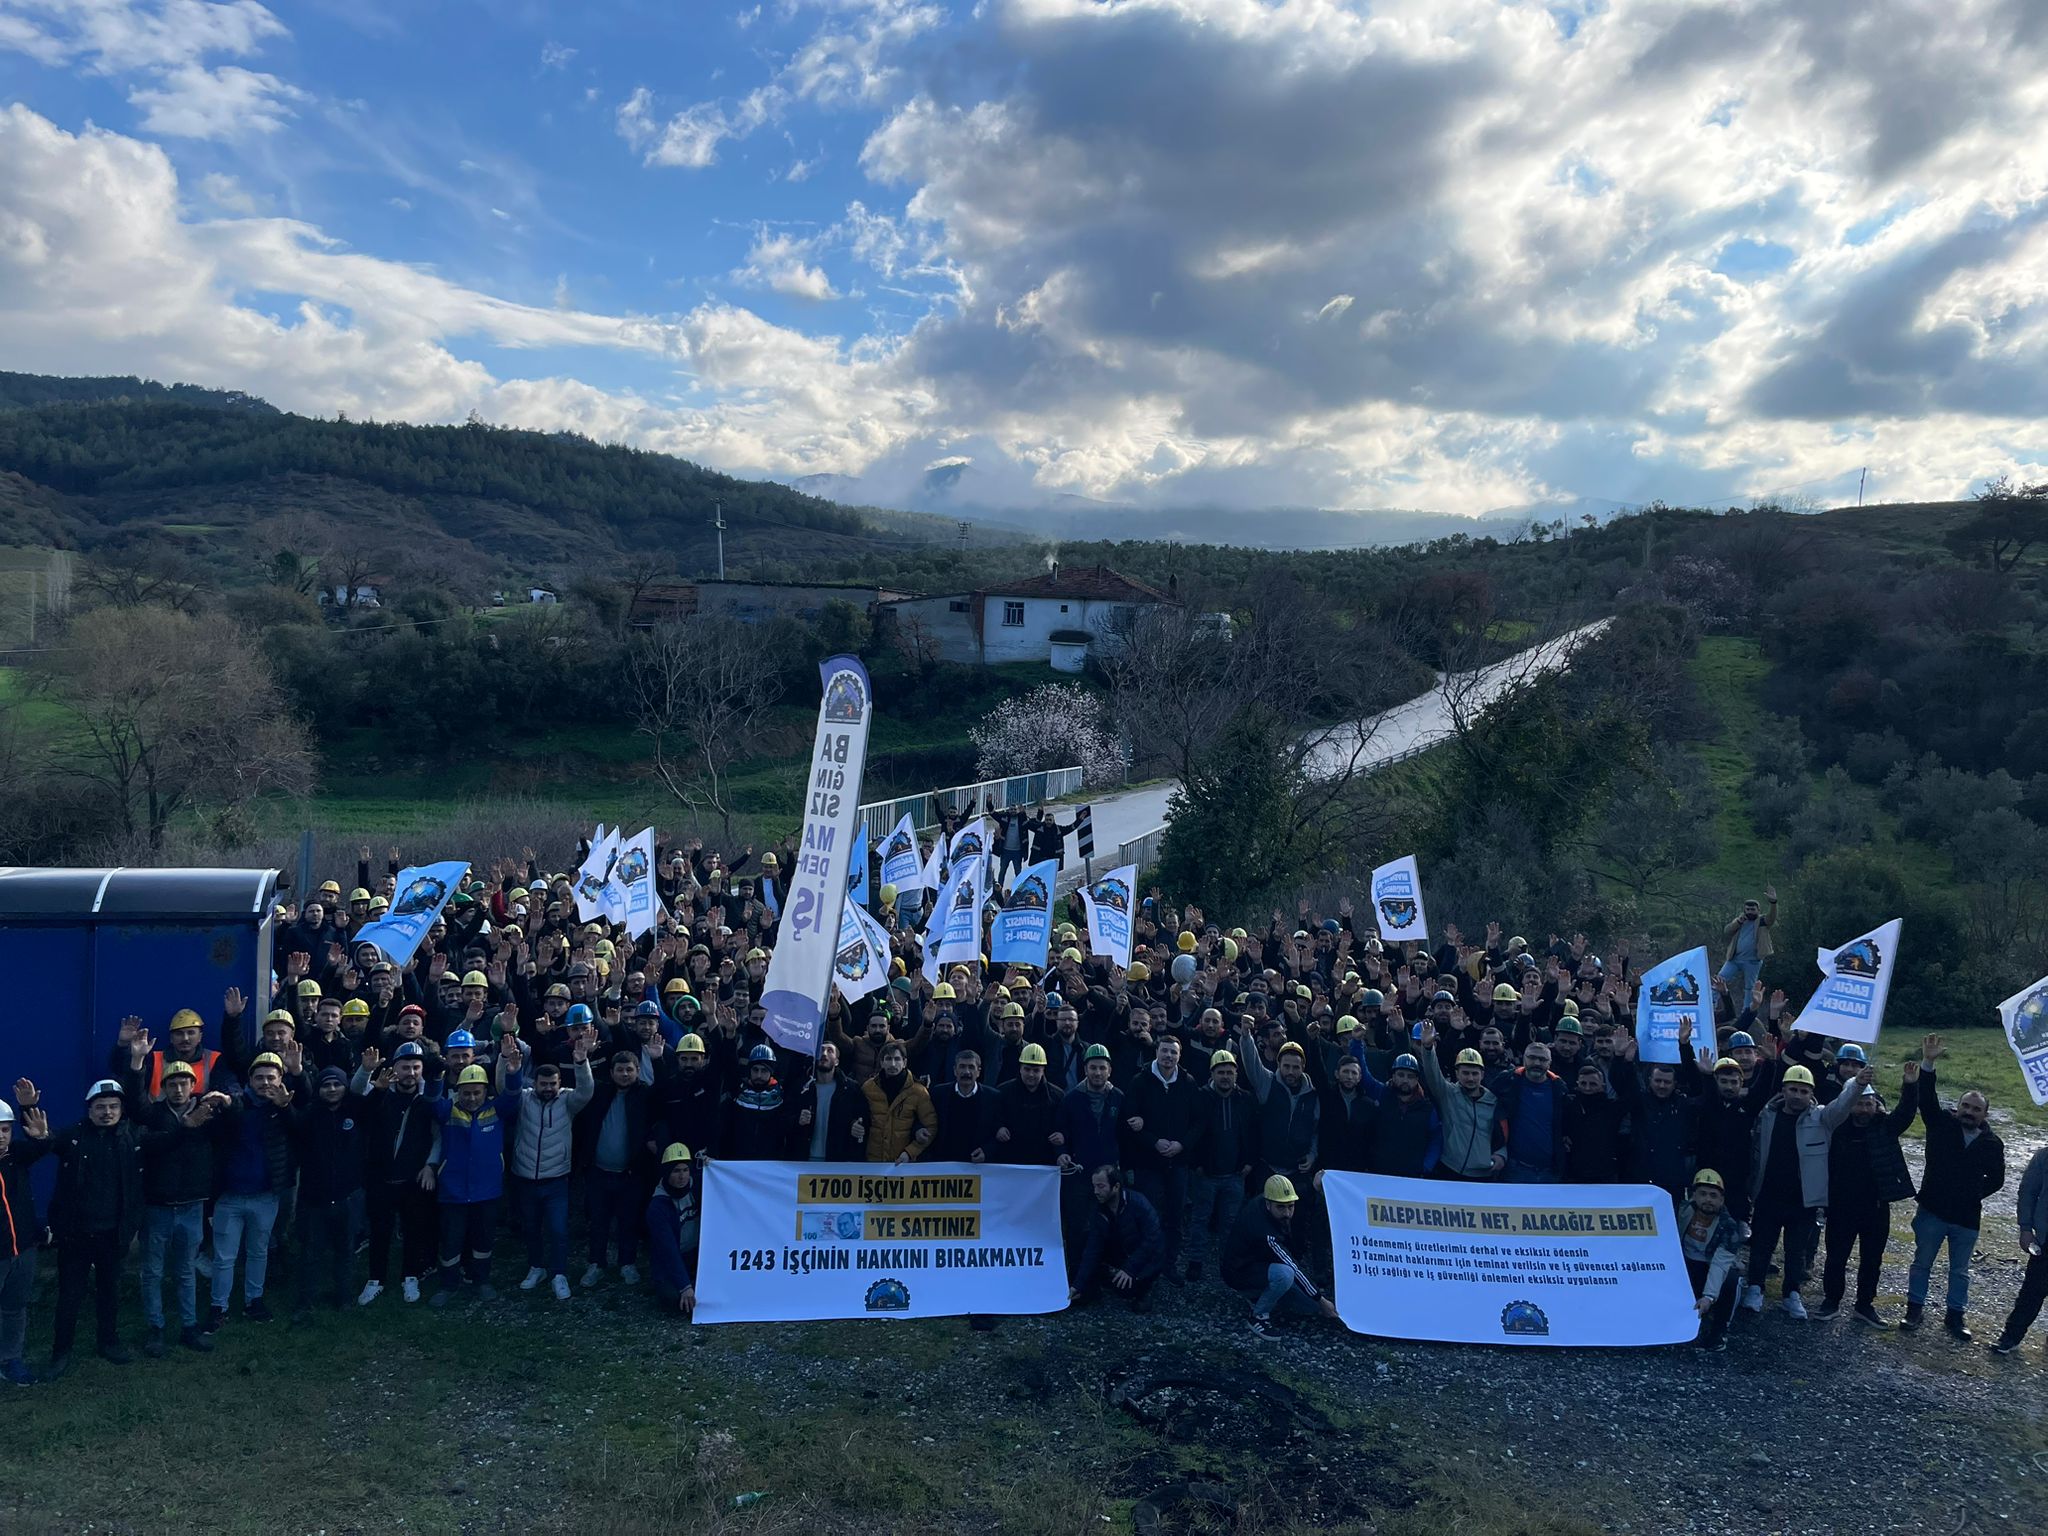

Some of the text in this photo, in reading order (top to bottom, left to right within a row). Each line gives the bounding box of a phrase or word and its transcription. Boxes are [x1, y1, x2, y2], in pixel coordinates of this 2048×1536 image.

[808, 1176, 973, 1203] 1700 İŞÇİYİ ATTINIZ
[870, 1217, 975, 1237] 'YE SATTINIZ
[1370, 1204, 1477, 1229] TALEPLERİMİZ
[1521, 1211, 1595, 1231] ALACAĞIZ
[1599, 1213, 1653, 1231] ELBET!
[1362, 1235, 1412, 1252] Ödenmemiş
[1415, 1241, 1467, 1254] ücretlerimiz
[1470, 1245, 1498, 1256] derhal
[1501, 1247, 1512, 1256] ve
[1514, 1247, 1551, 1257] eksiksiz
[1553, 1247, 1590, 1258] ödensin
[728, 1245, 1044, 1274] 1243 İŞÇİNİN HAKKINI BIRAKMAYIZ
[1363, 1250, 1403, 1263] Tazminat
[1405, 1255, 1453, 1267] haklarımız
[1455, 1257, 1471, 1269] için
[1474, 1259, 1509, 1270] teminat
[1512, 1260, 1547, 1271] verilsin
[1549, 1262, 1560, 1271] ve
[1562, 1261, 1571, 1273] iş
[1573, 1261, 1619, 1272] güvencesi
[1621, 1262, 1666, 1273] sağlansın
[1381, 1265, 1411, 1278] sağlığı
[1413, 1269, 1424, 1279] ve
[1426, 1269, 1435, 1281] iş
[1437, 1271, 1479, 1283] güvenliği
[1481, 1273, 1525, 1284] önlemleri
[1527, 1274, 1565, 1285] eksiksiz
[1567, 1275, 1618, 1286] uygulansın
